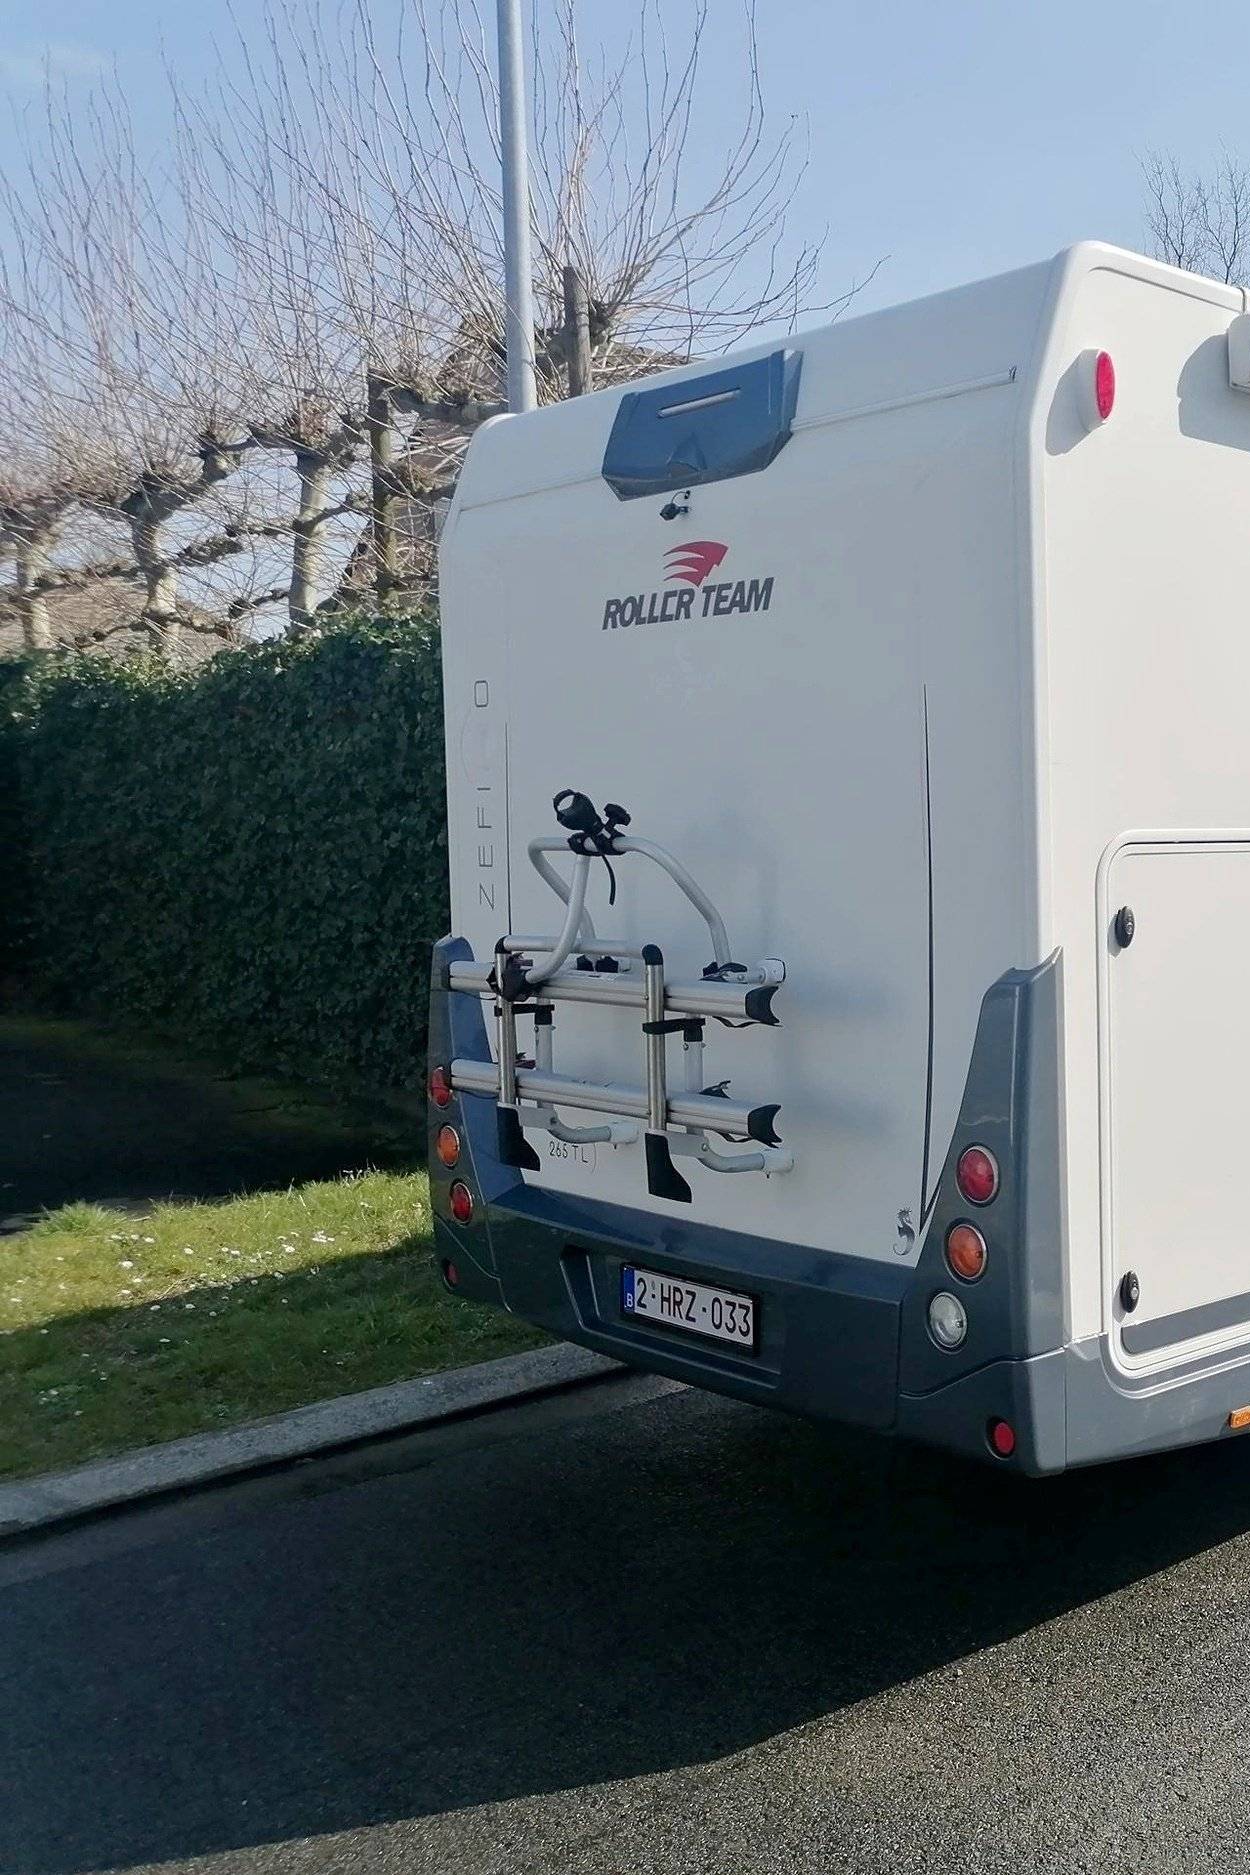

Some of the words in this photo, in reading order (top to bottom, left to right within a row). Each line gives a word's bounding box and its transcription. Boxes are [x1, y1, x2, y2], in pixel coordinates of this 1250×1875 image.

[601, 587, 696, 631] ROLLER
[701, 576, 775, 618] TEAM
[549, 1140, 568, 1159] 265
[571, 1144, 588, 1163] TL
[626, 1292, 634, 1308] B
